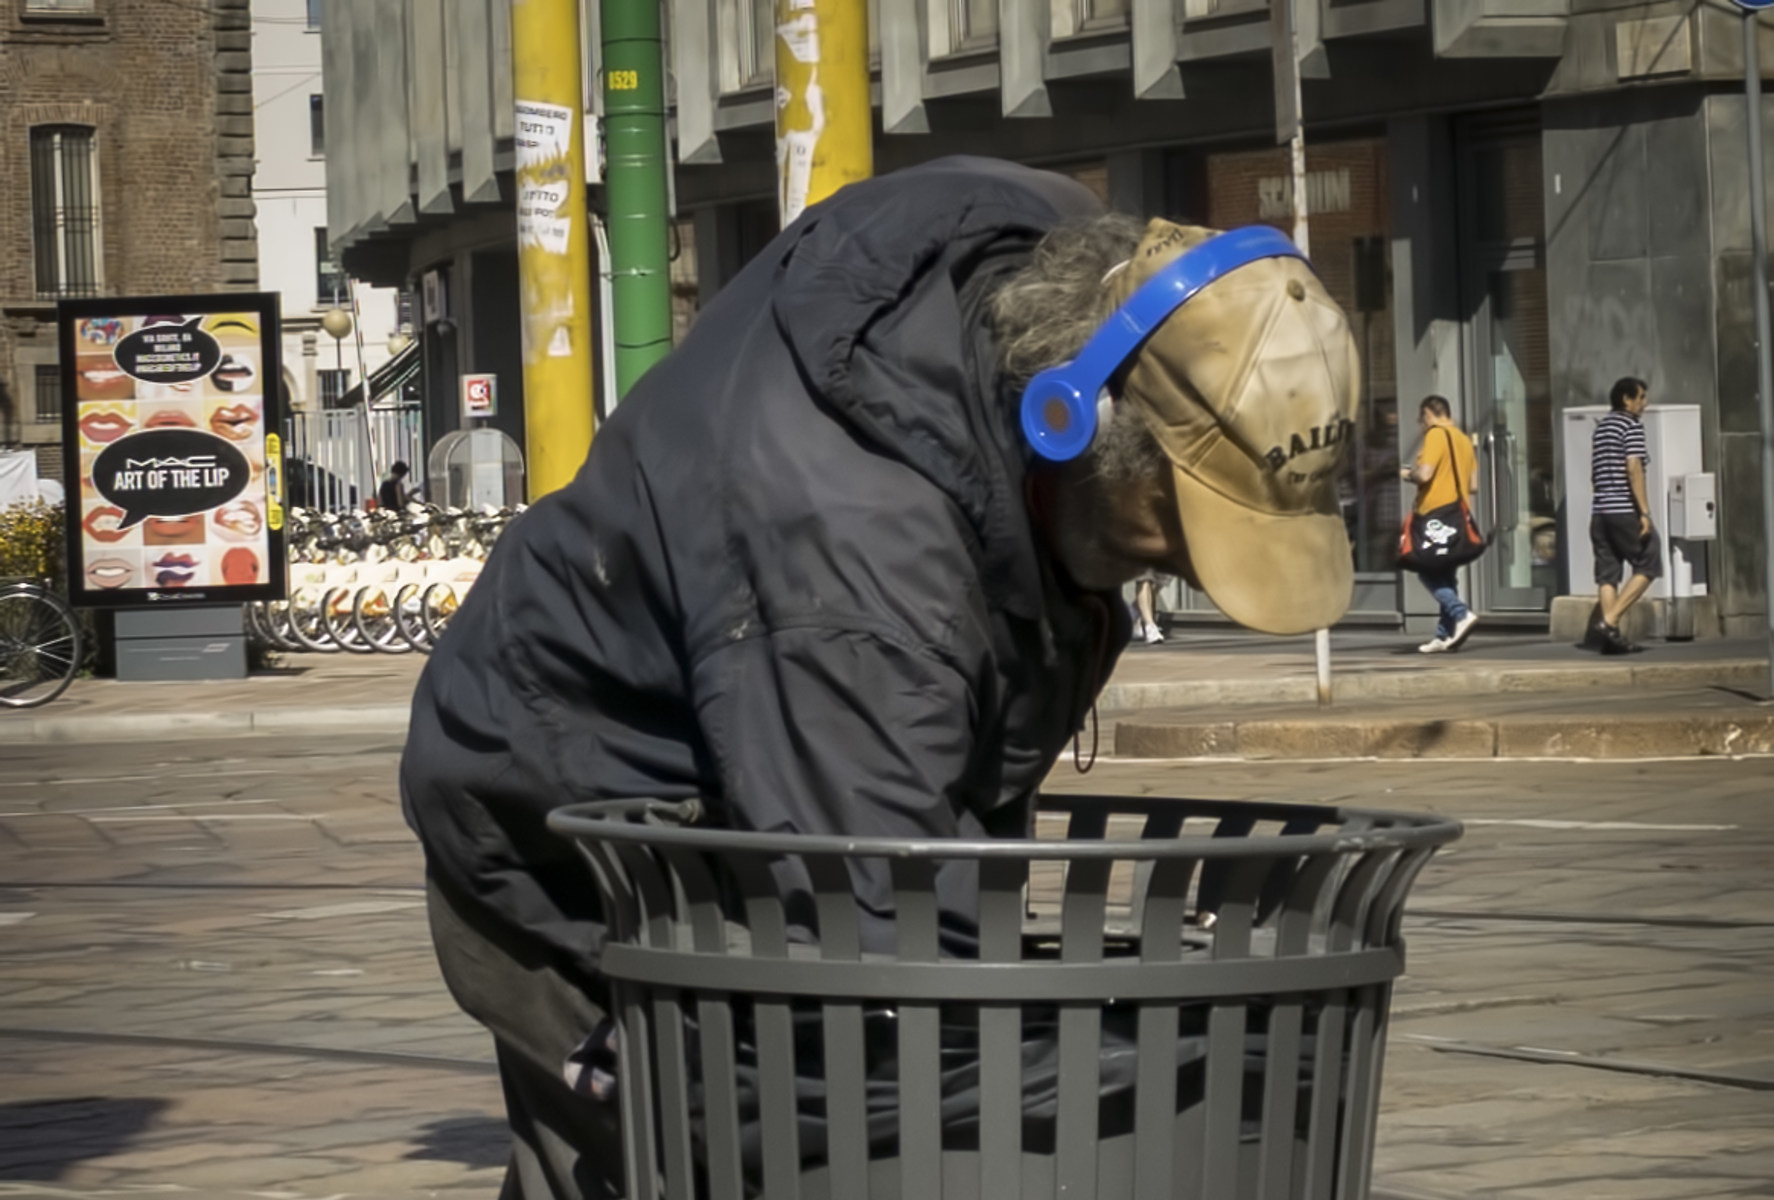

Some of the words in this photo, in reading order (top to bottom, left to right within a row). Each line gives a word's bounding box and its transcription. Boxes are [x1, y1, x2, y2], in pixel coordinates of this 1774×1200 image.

[126, 454, 217, 469] MAC
[113, 470, 144, 491] ART
[147, 469, 168, 490] OF
[170, 468, 201, 488] THE
[203, 467, 231, 487] LIP
